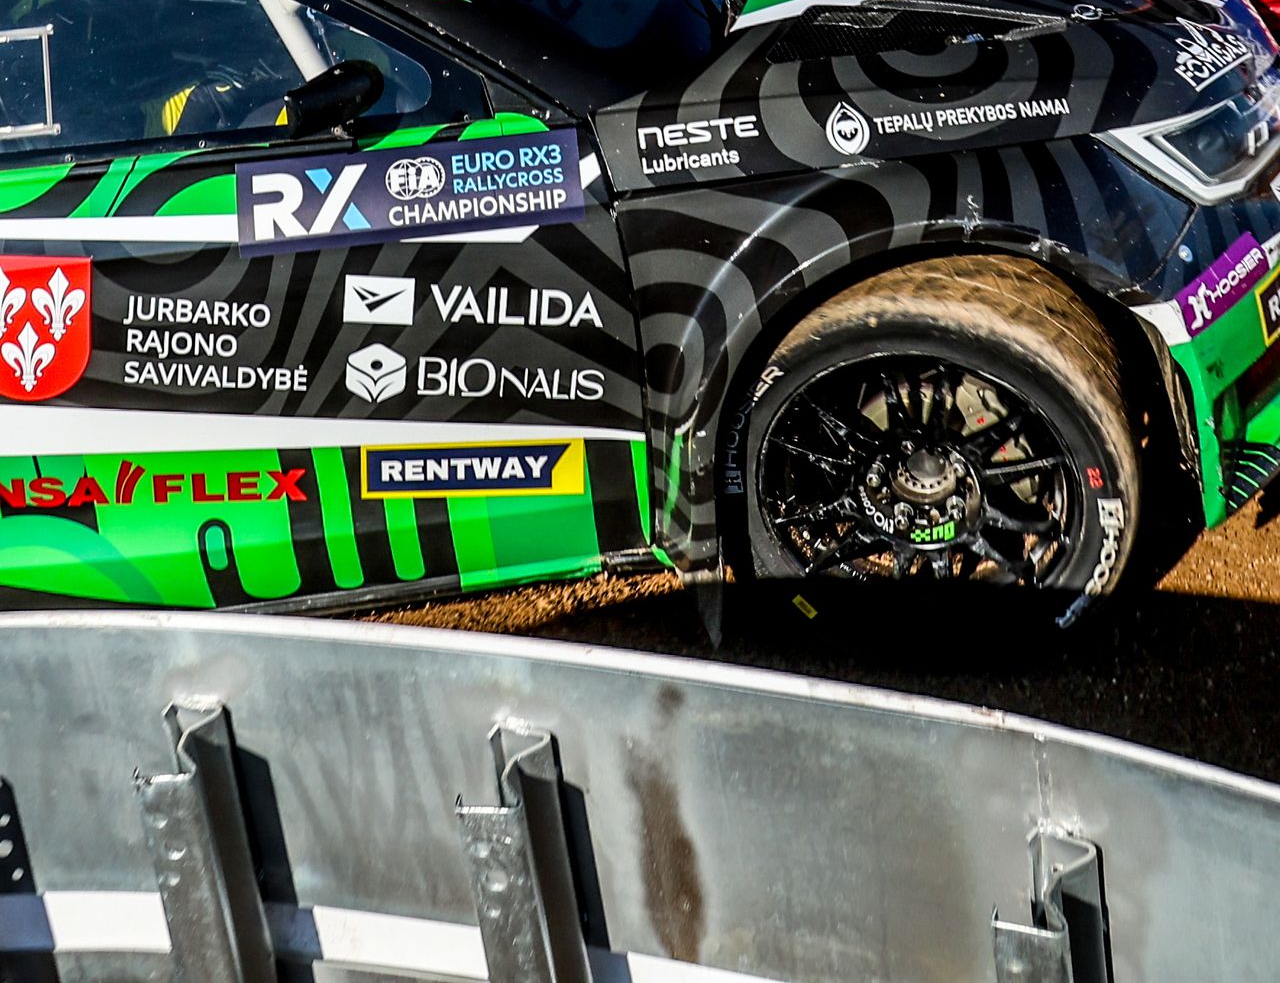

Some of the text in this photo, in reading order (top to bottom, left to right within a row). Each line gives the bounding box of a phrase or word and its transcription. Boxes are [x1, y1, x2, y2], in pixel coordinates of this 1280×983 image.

[872, 97, 1071, 136] TEPALŲ PREKYBOS NAMAI
[451, 143, 563, 176] EURO RX3
[641, 148, 740, 175] Lubricants
[452, 167, 565, 195] RALLYCROSS
[253, 164, 373, 236] RX
[388, 188, 568, 227] CHAMPIONSHIP
[1205, 246, 1265, 304] HOOSIER
[123, 294, 272, 328] JURBARKO
[429, 283, 604, 328] VAILIDA
[124, 327, 237, 360] RAJONO
[123, 358, 309, 393] SAVIVALDYBĖ
[379, 455, 550, 483] RENTWAY
